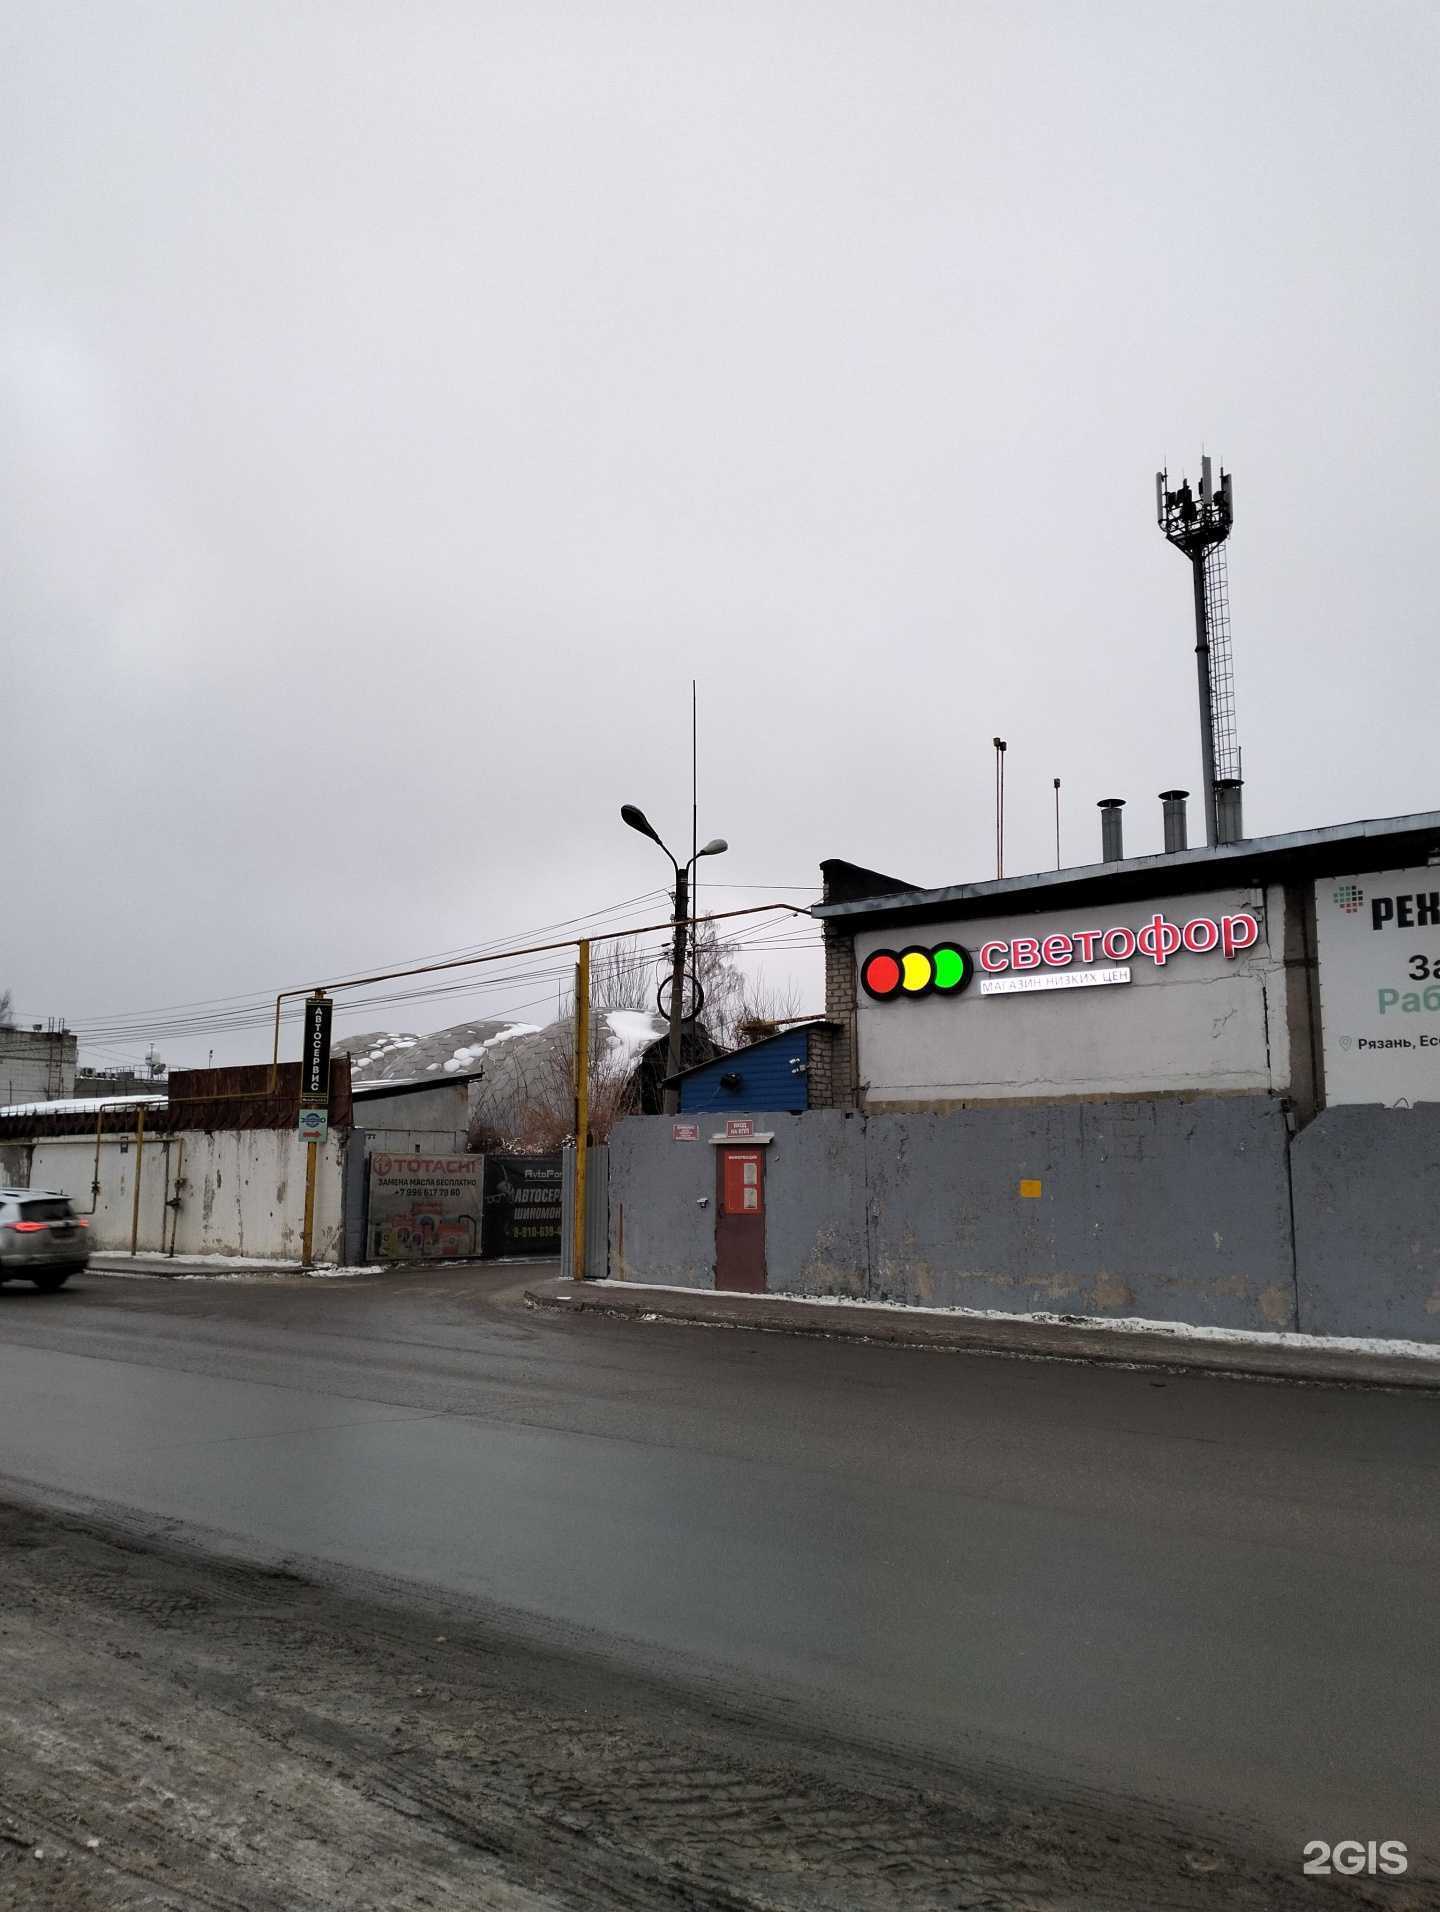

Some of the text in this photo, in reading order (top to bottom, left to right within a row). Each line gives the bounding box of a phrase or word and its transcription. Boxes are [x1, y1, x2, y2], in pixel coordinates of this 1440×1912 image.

[979, 913, 1259, 972] светофор
[982, 970, 1128, 993] МАГАЗИН НИЗКИХ ЦЕН
[311, 1007, 323, 1091] АВТОСЕРВИС
[1358, 1035, 1440, 1050] Рязань, Ес
[393, 1159, 477, 1174] TOTACHI
[378, 1179, 477, 1187] ЗАМЕНА МАСЛА БЕСПЛАТНО
[514, 1189, 562, 1203] АВТОСЕР
